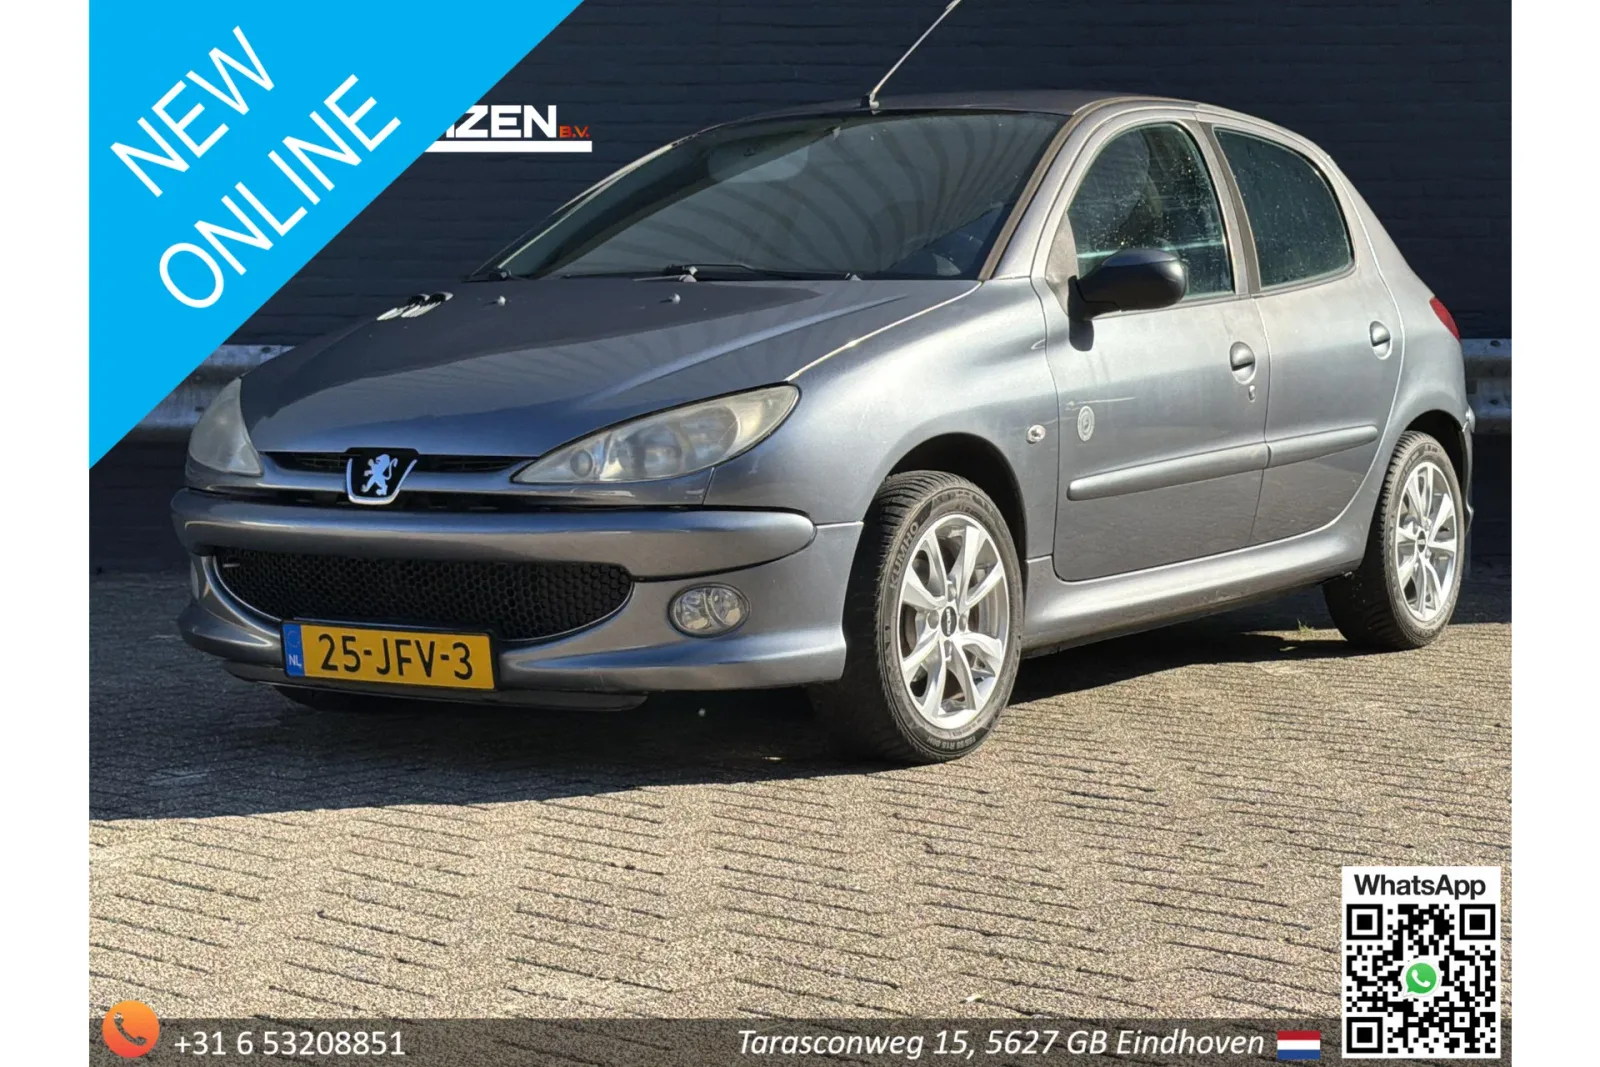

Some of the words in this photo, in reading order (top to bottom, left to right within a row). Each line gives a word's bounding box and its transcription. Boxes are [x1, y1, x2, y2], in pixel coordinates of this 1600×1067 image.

[890, 522, 918, 588] KUMHO
[288, 654, 302, 667] NL
[318, 633, 473, 681] 25-JFV-3
